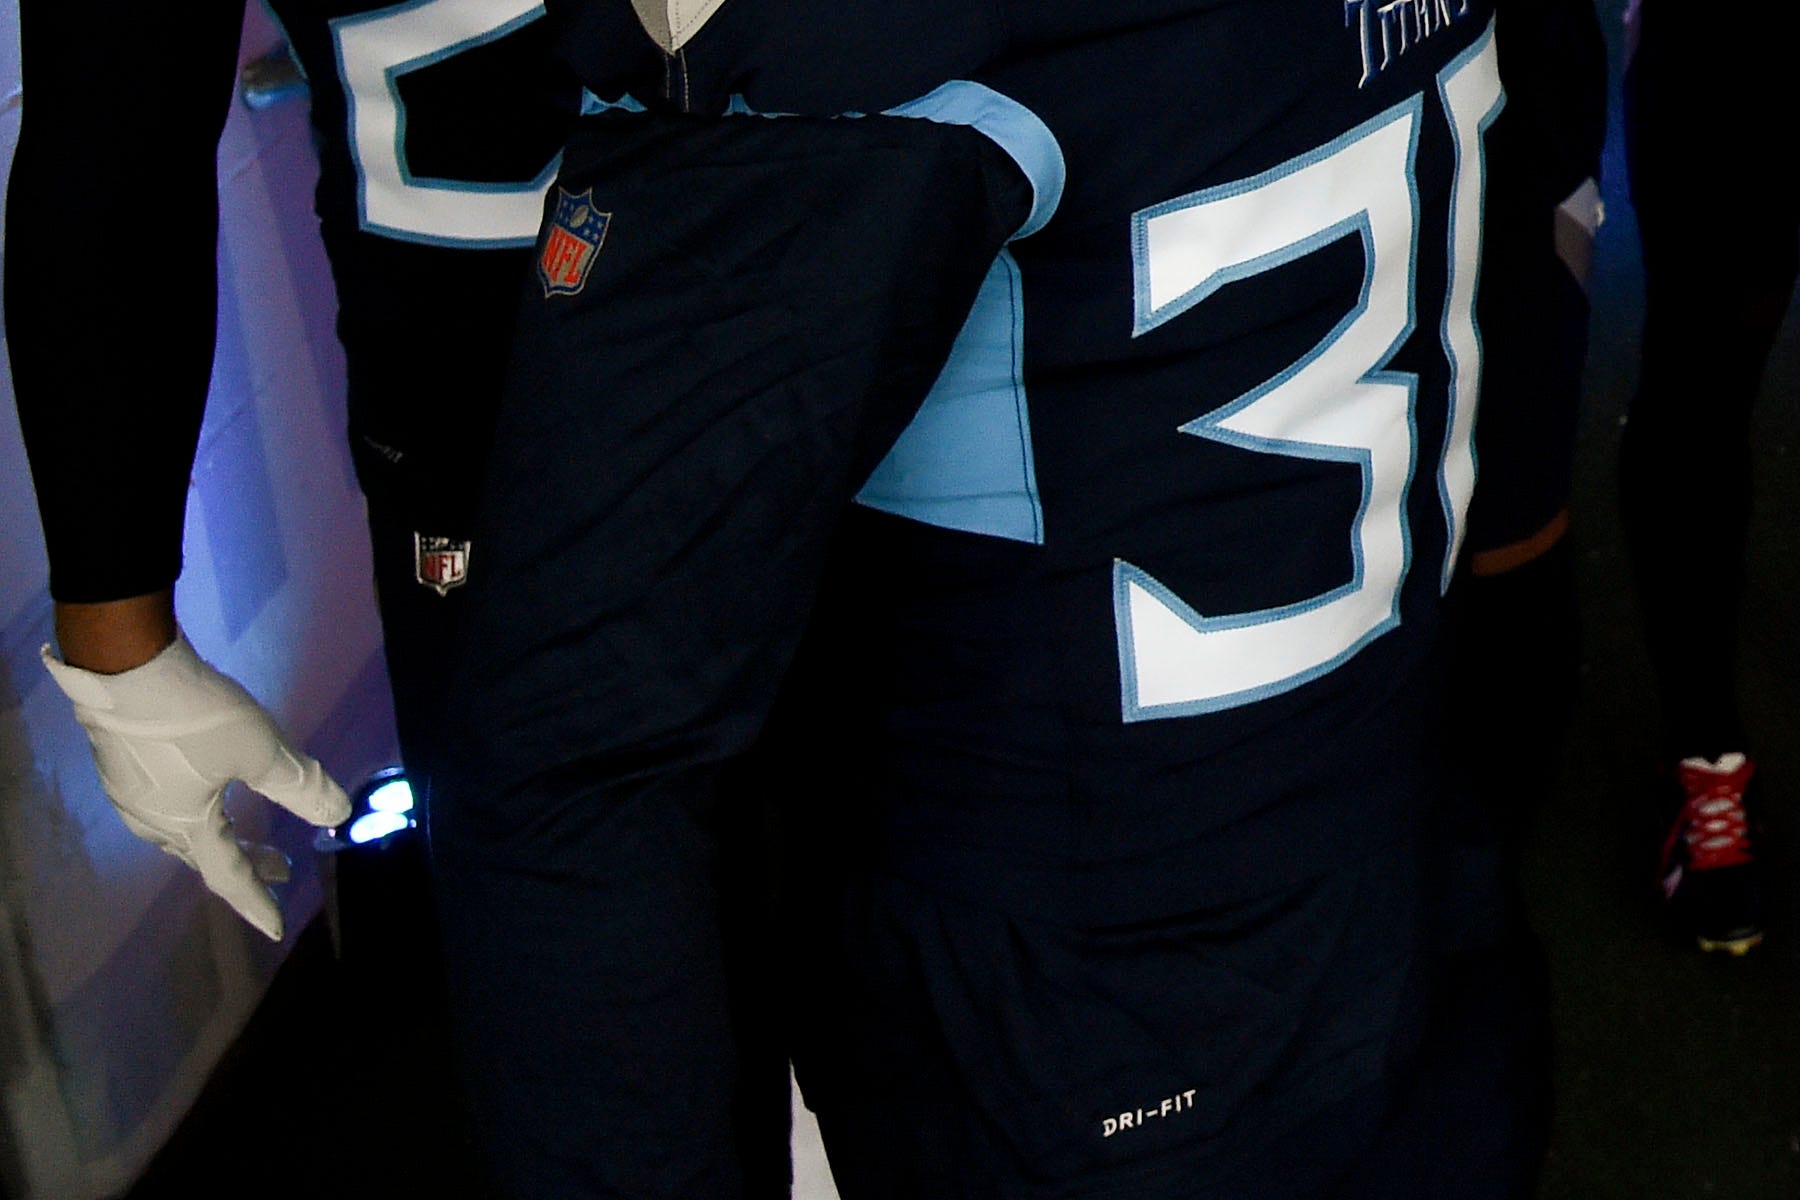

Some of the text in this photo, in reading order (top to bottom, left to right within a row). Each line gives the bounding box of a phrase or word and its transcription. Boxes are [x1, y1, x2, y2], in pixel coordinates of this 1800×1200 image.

[541, 227, 589, 285] NFL
[423, 554, 461, 581] NFL
[1102, 1089, 1197, 1138] DRI-FIT
